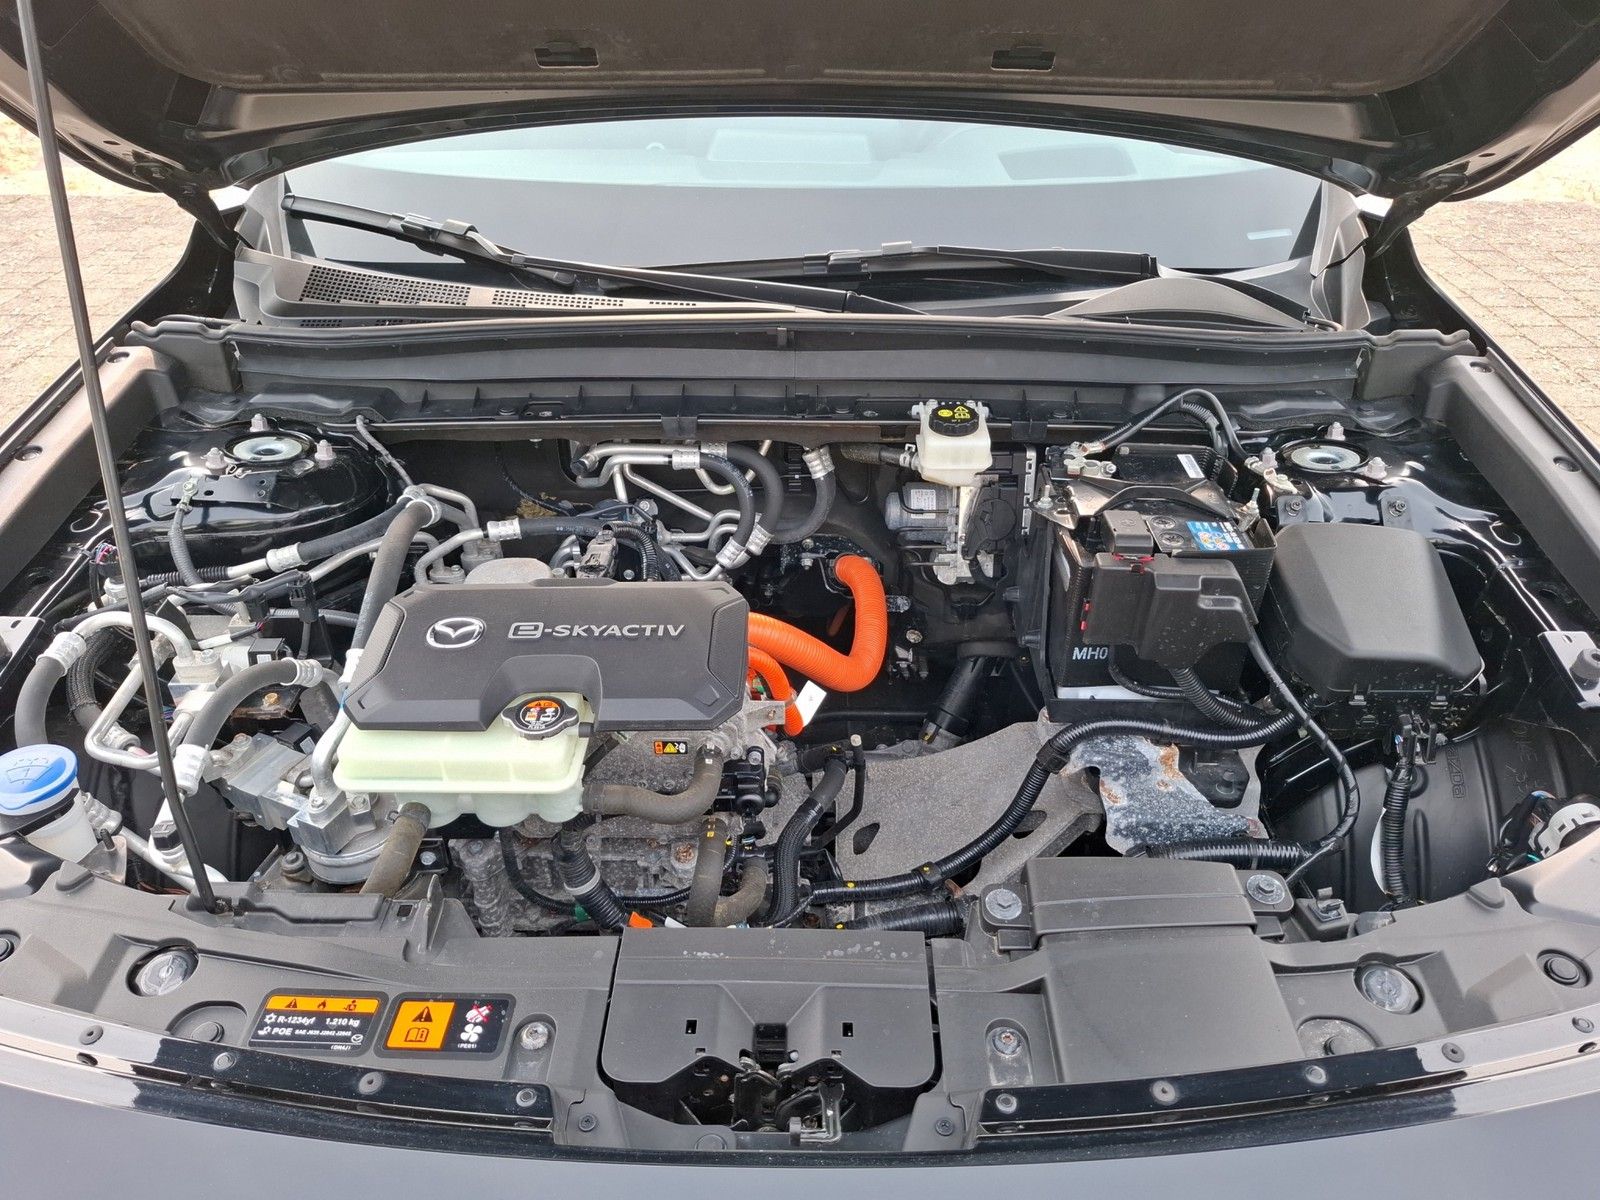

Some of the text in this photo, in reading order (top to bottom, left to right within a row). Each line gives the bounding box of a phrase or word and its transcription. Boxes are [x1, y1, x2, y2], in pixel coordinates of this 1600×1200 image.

[276, 1015, 361, 1028] R-1234yf 1.210 kg
[271, 1027, 294, 1036] POE
